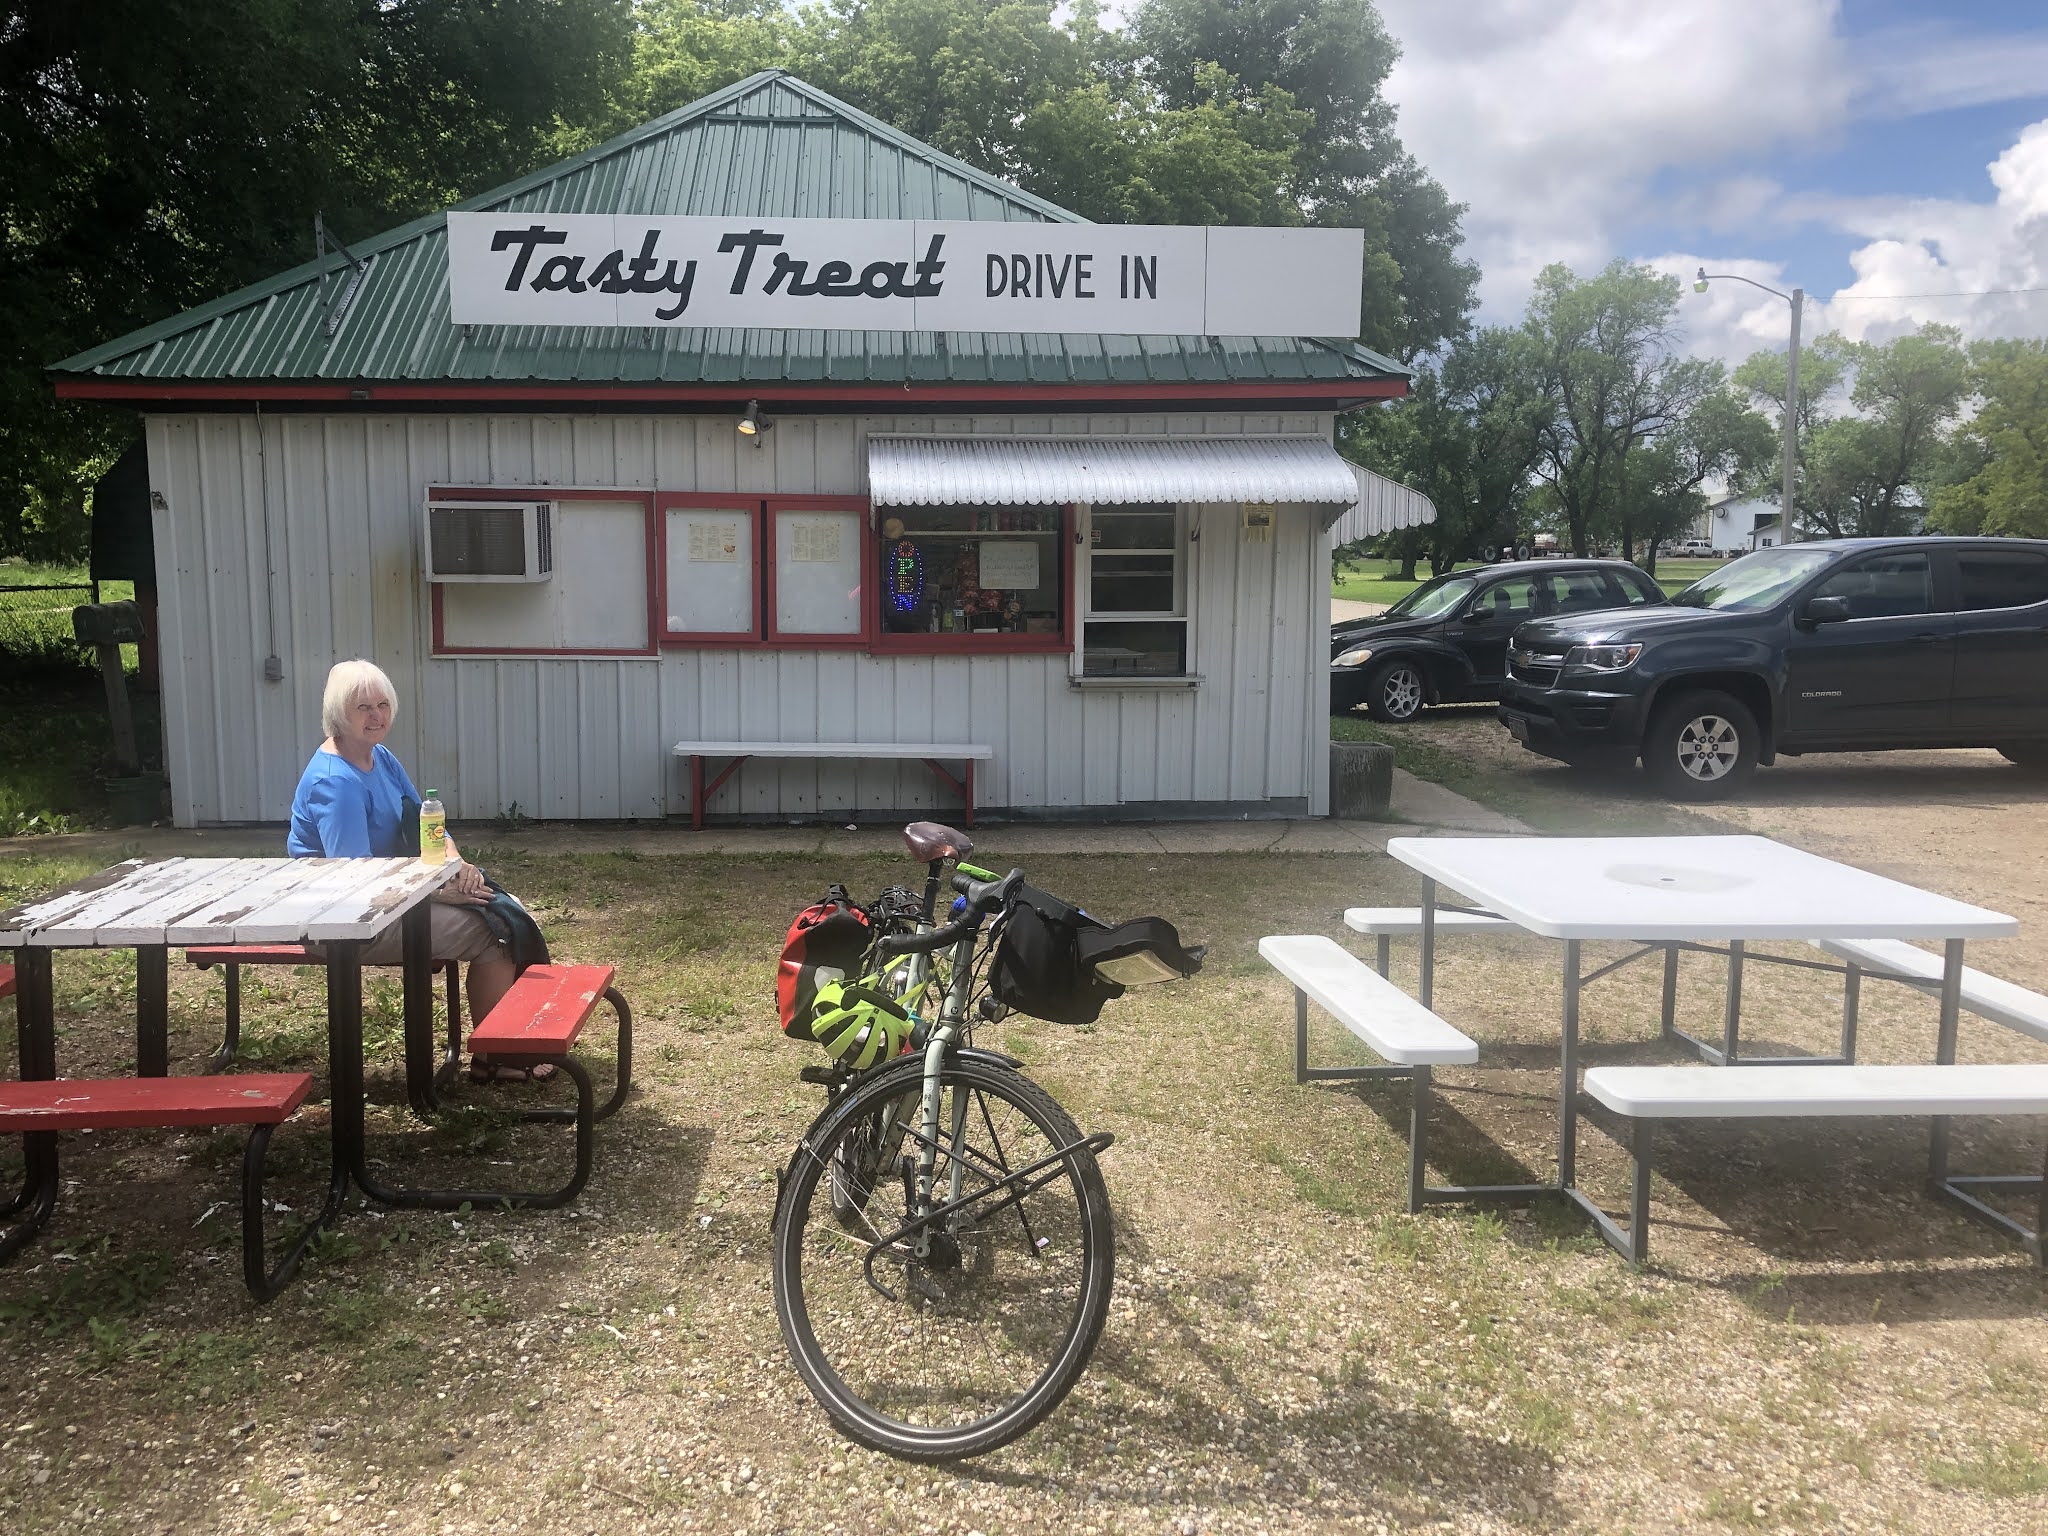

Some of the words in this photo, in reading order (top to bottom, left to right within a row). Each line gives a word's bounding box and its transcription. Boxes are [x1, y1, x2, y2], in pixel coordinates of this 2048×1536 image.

[490, 225, 698, 320] Tasty
[717, 229, 947, 298] Treat
[986, 253, 1096, 298] DRIVE
[1120, 255, 1158, 299] IN
[897, 541, 915, 611] OPEN
[1801, 690, 1842, 698] COLORADO
